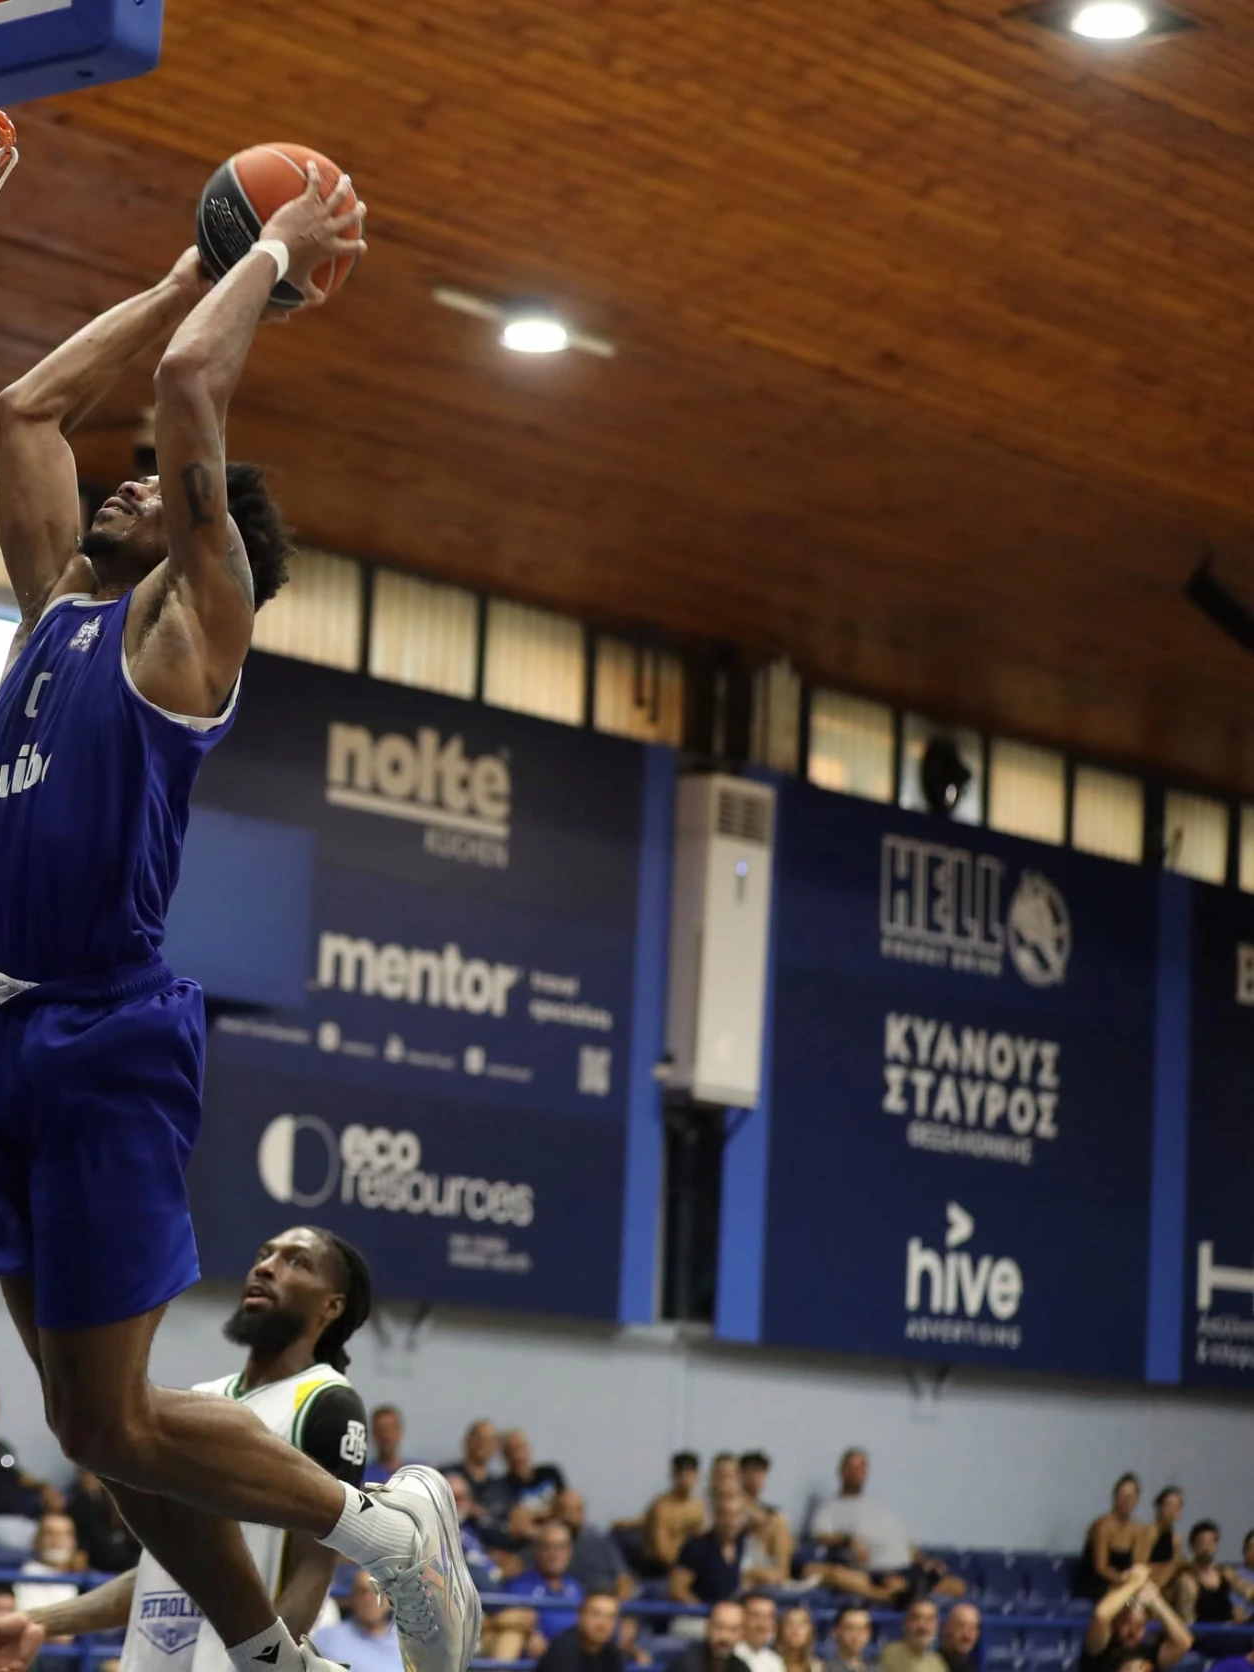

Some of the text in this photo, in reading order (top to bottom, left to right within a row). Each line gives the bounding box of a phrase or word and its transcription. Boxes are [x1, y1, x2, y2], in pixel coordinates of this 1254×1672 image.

[328, 722, 511, 818] nolte
[318, 931, 519, 1017] mentor
[340, 1122, 422, 1171] eco
[340, 1167, 535, 1228] resources
[905, 1200, 1024, 1321] hive
